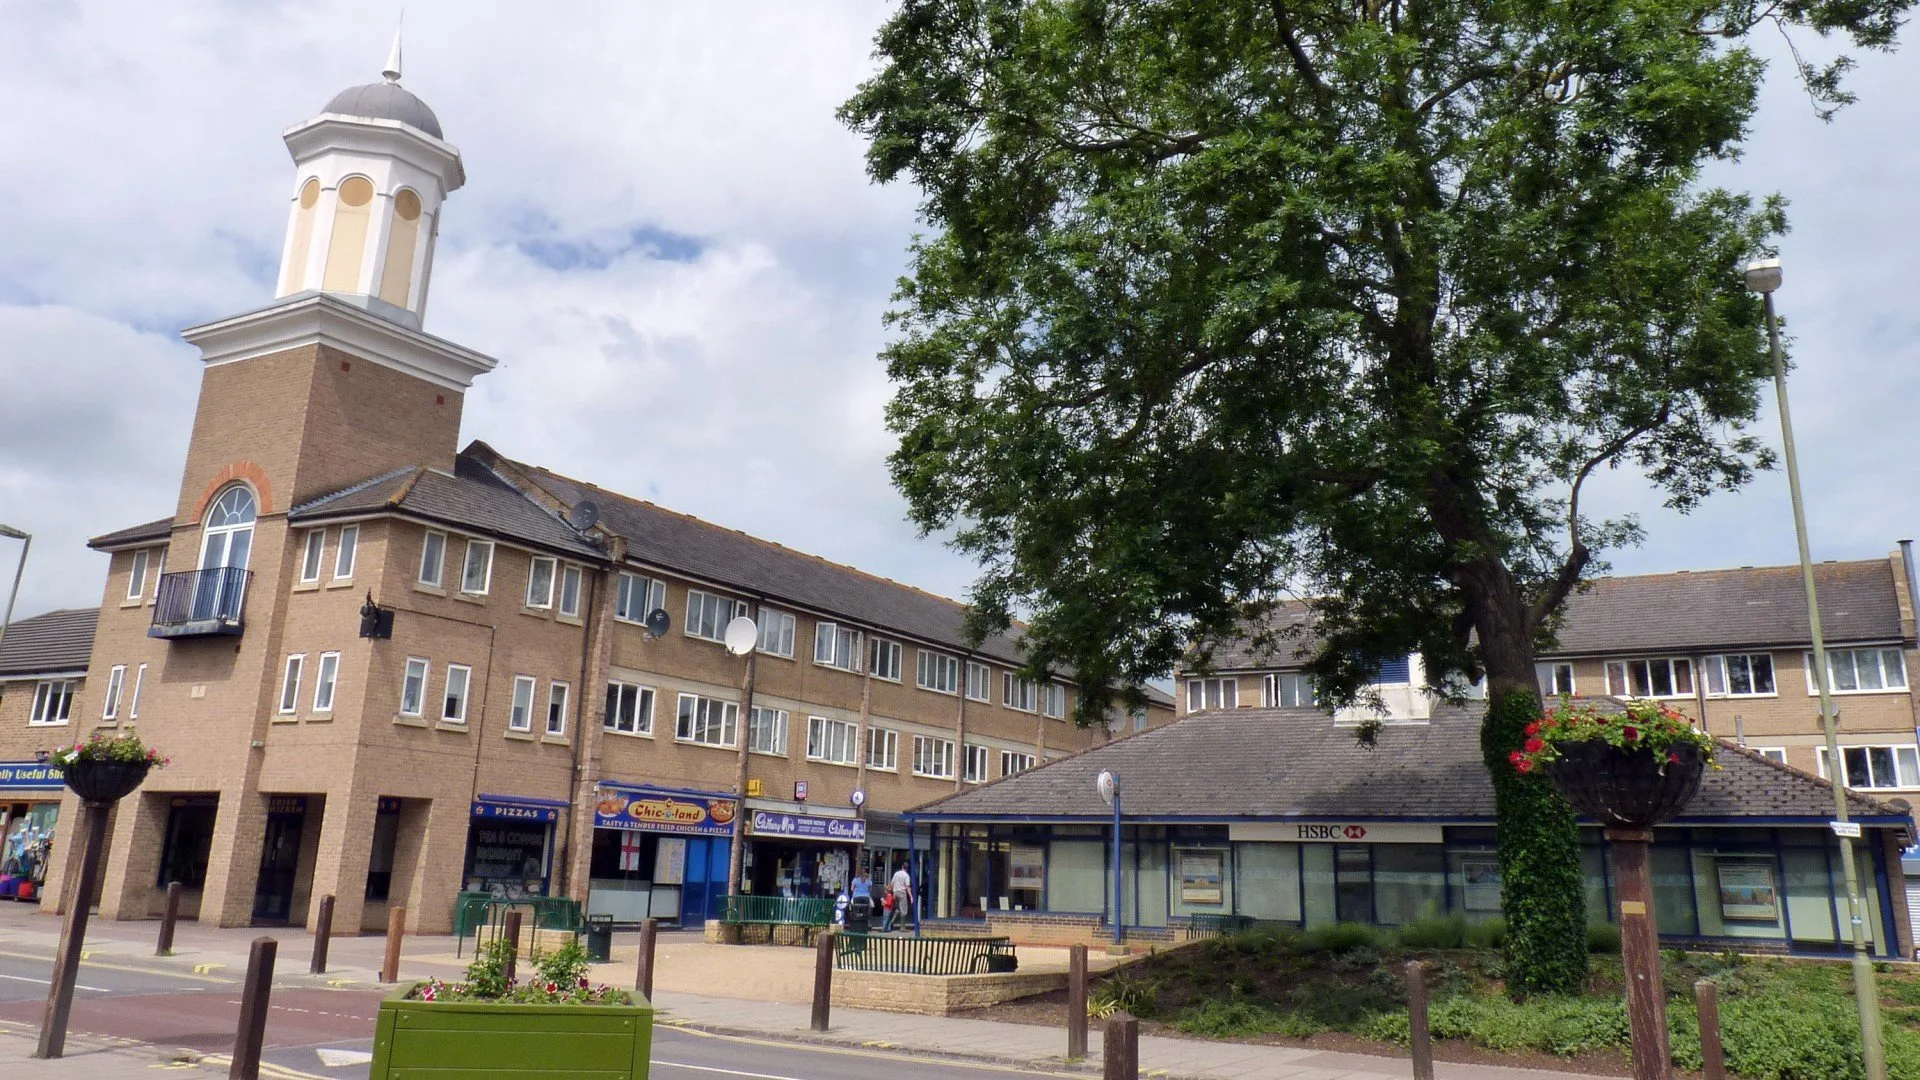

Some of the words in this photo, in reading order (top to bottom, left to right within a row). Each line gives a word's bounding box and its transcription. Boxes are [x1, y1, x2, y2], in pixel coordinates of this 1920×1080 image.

[16, 769, 46, 779] Useful
[495, 807, 538, 817] PIZZAS
[630, 821, 656, 829] TENDER
[657, 823, 675, 831] FRIED
[676, 824, 703, 832] CHICKEN
[709, 827, 730, 835] PIZZAS
[755, 813, 782, 833] Cadbury
[828, 820, 853, 838] Cadbury
[1297, 825, 1341, 838] HSBC
